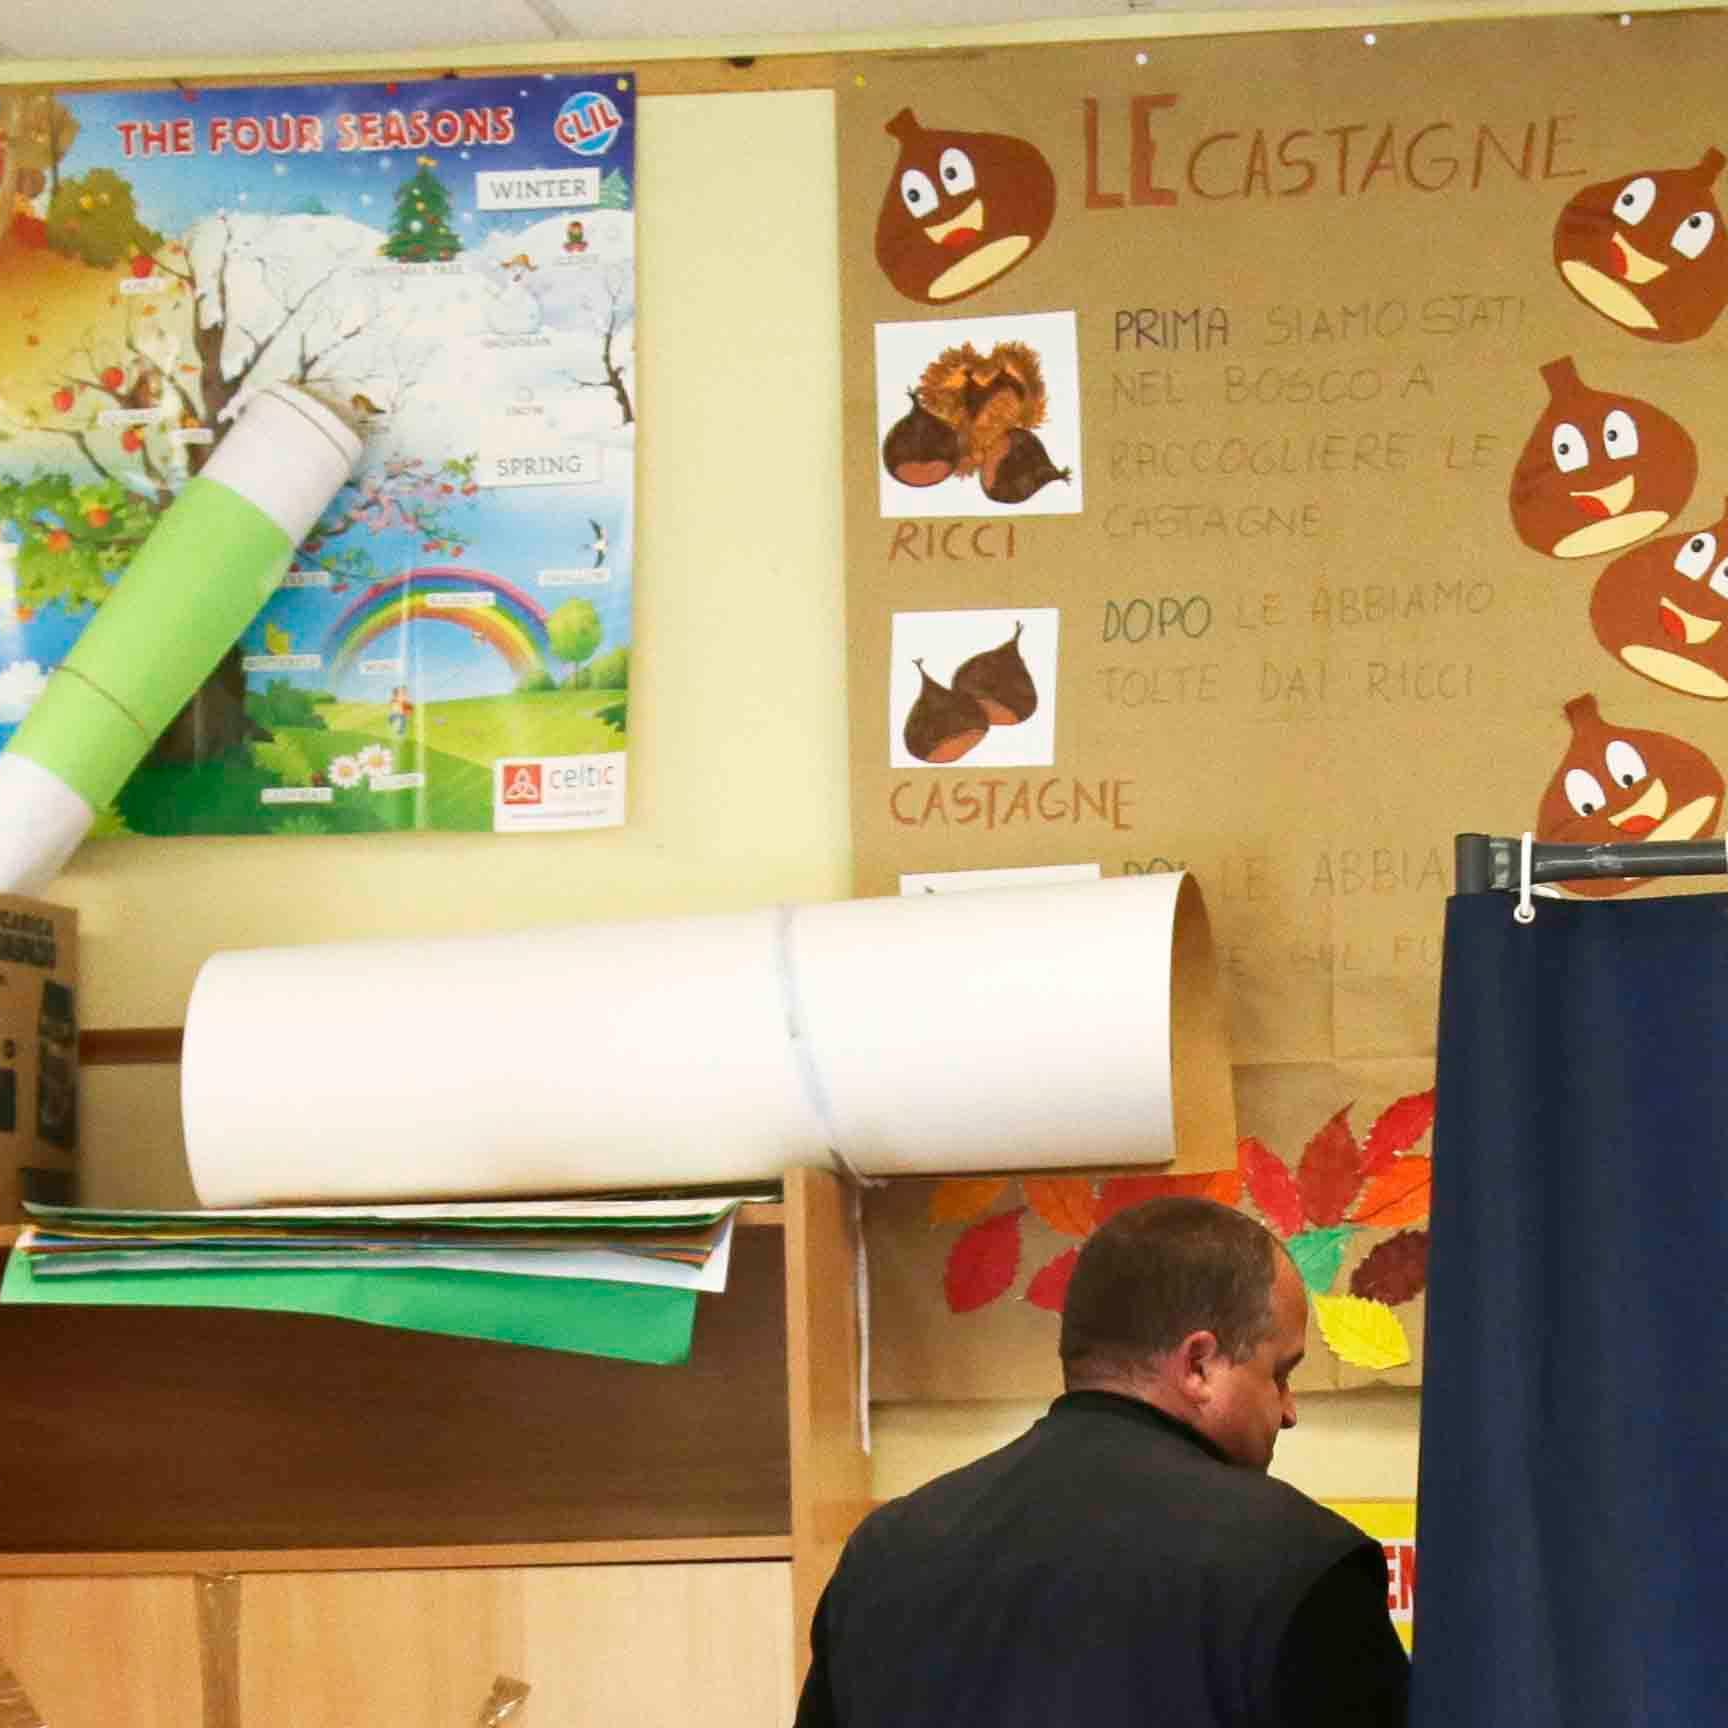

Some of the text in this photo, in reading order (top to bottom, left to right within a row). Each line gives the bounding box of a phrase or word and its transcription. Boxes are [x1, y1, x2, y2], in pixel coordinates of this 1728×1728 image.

[117, 106, 514, 158] THE FOUR SEASONS
[554, 100, 623, 148] CLIL
[1083, 93, 1590, 211] LE CASTAGNE
[489, 178, 588, 200] WINTER
[1113, 305, 1232, 354] PRIMA
[1263, 298, 1408, 348] SIAMO
[1111, 361, 1435, 416] NEL BOSCO A
[495, 455, 583, 477] SPRING
[1110, 431, 1500, 482] RACCOGLIERE LE
[888, 521, 1017, 561] RICCI
[1102, 502, 1325, 541] CASTAGNE
[1101, 581, 1496, 644] DOPO LE ABBIAMO
[1096, 662, 1221, 709] TOLTE
[1366, 660, 1476, 703] RICCI
[549, 763, 616, 790] celtic
[889, 775, 1136, 832] CASTAGNE
[1310, 846, 1449, 898] ABBIA
